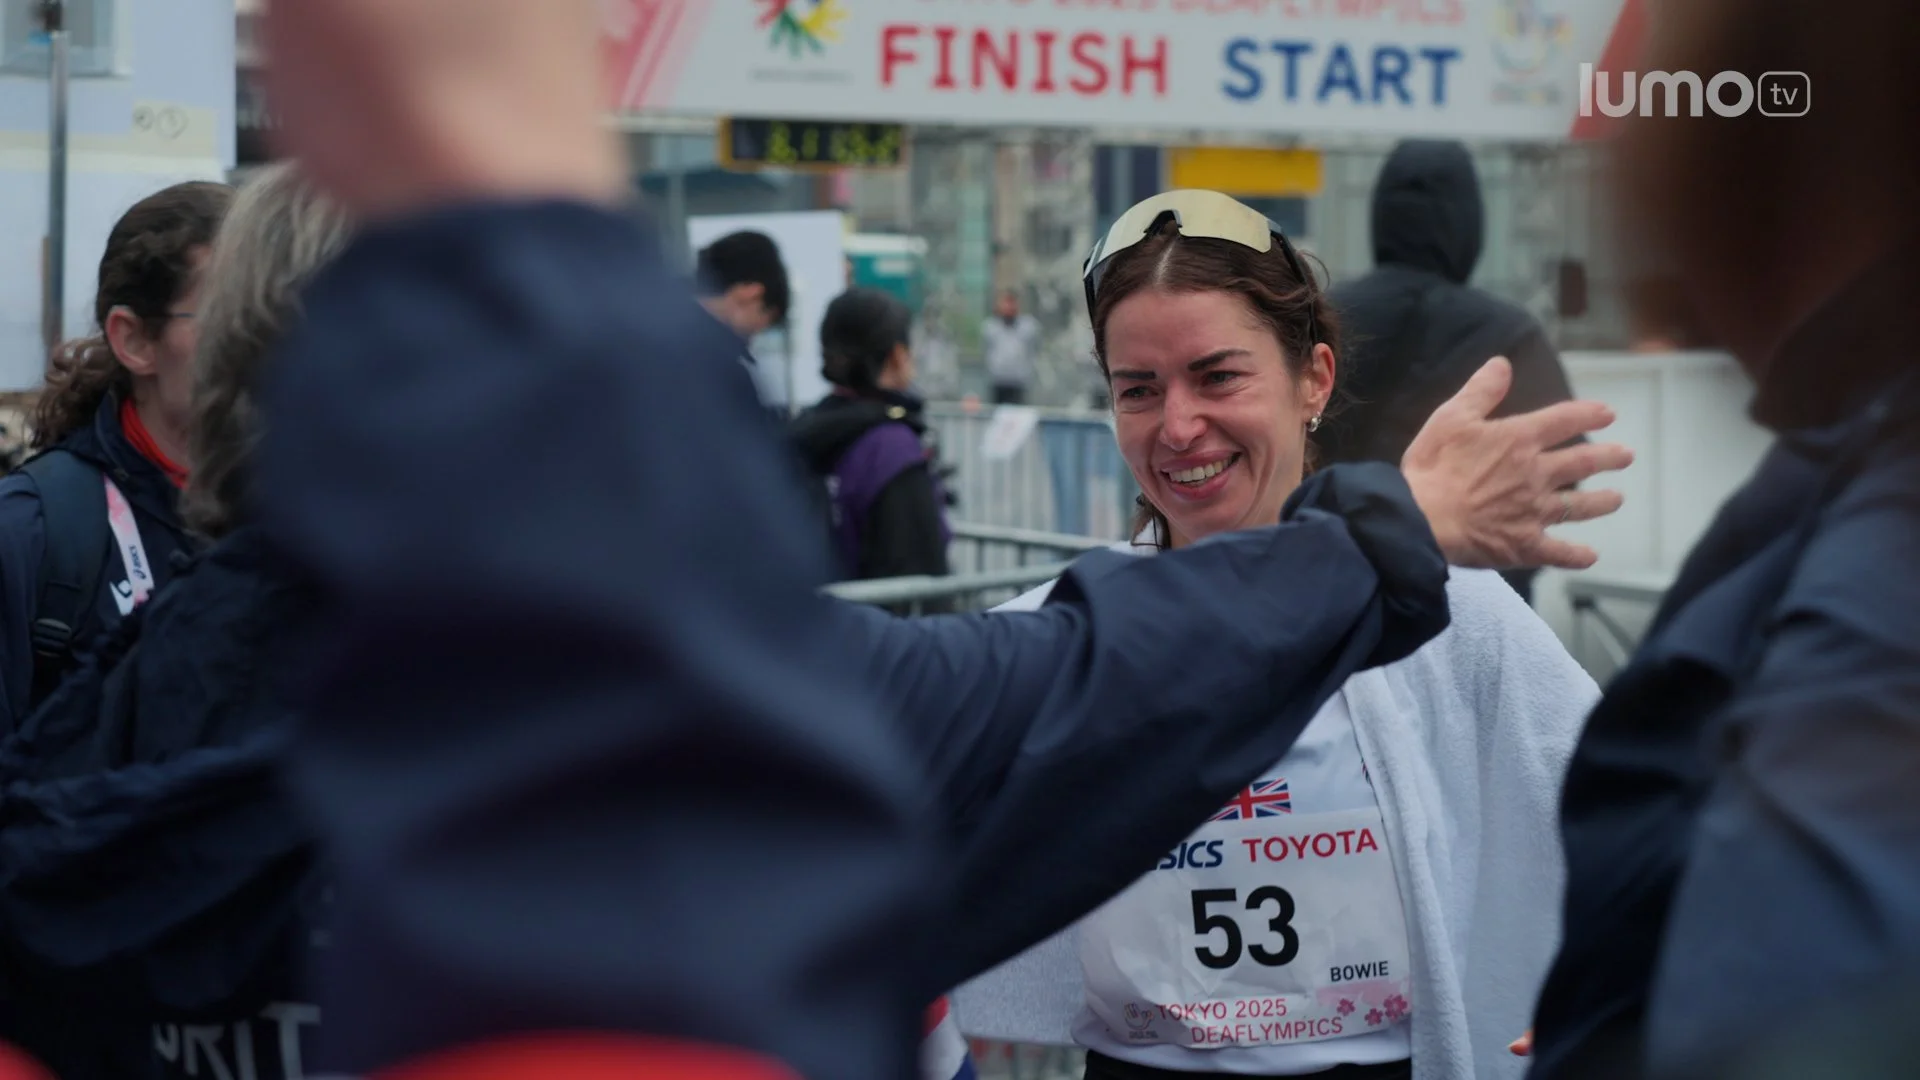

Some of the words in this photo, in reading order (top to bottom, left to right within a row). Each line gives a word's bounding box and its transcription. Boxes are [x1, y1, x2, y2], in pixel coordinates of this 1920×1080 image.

[880, 24, 1167, 95] FINISH
[1221, 38, 1462, 104] START
[1153, 839, 1224, 871] SICS
[1242, 828, 1379, 863] TOYOTA
[1191, 885, 1299, 970] 53
[1330, 960, 1389, 982] BOWIE
[1155, 1001, 1227, 1021] TOKYO
[1235, 998, 1288, 1018] 2025
[1191, 1016, 1344, 1043] DEAFLYMPICS
